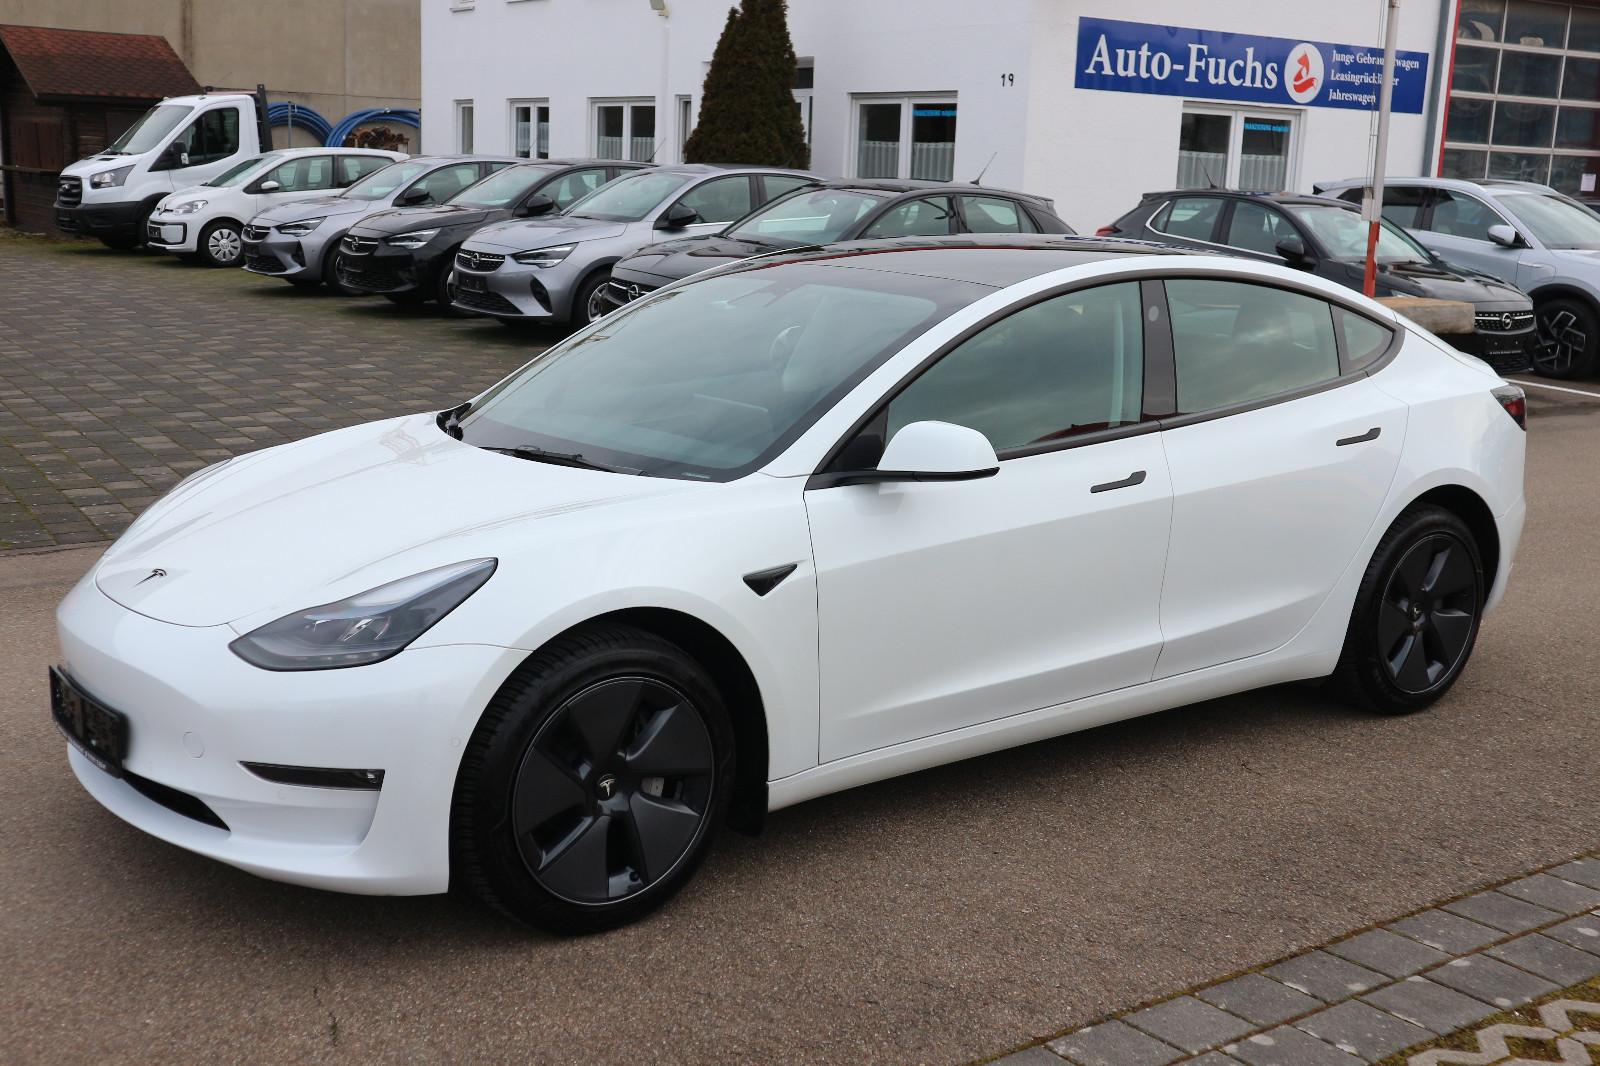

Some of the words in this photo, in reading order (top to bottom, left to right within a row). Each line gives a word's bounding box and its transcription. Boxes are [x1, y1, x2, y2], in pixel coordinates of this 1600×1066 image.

[1084, 33, 1279, 90] Auto-Fuchs
[1332, 50, 1355, 66] Junge
[1000, 73, 1014, 87] 19
[1328, 89, 1377, 106] Jahreswagen
